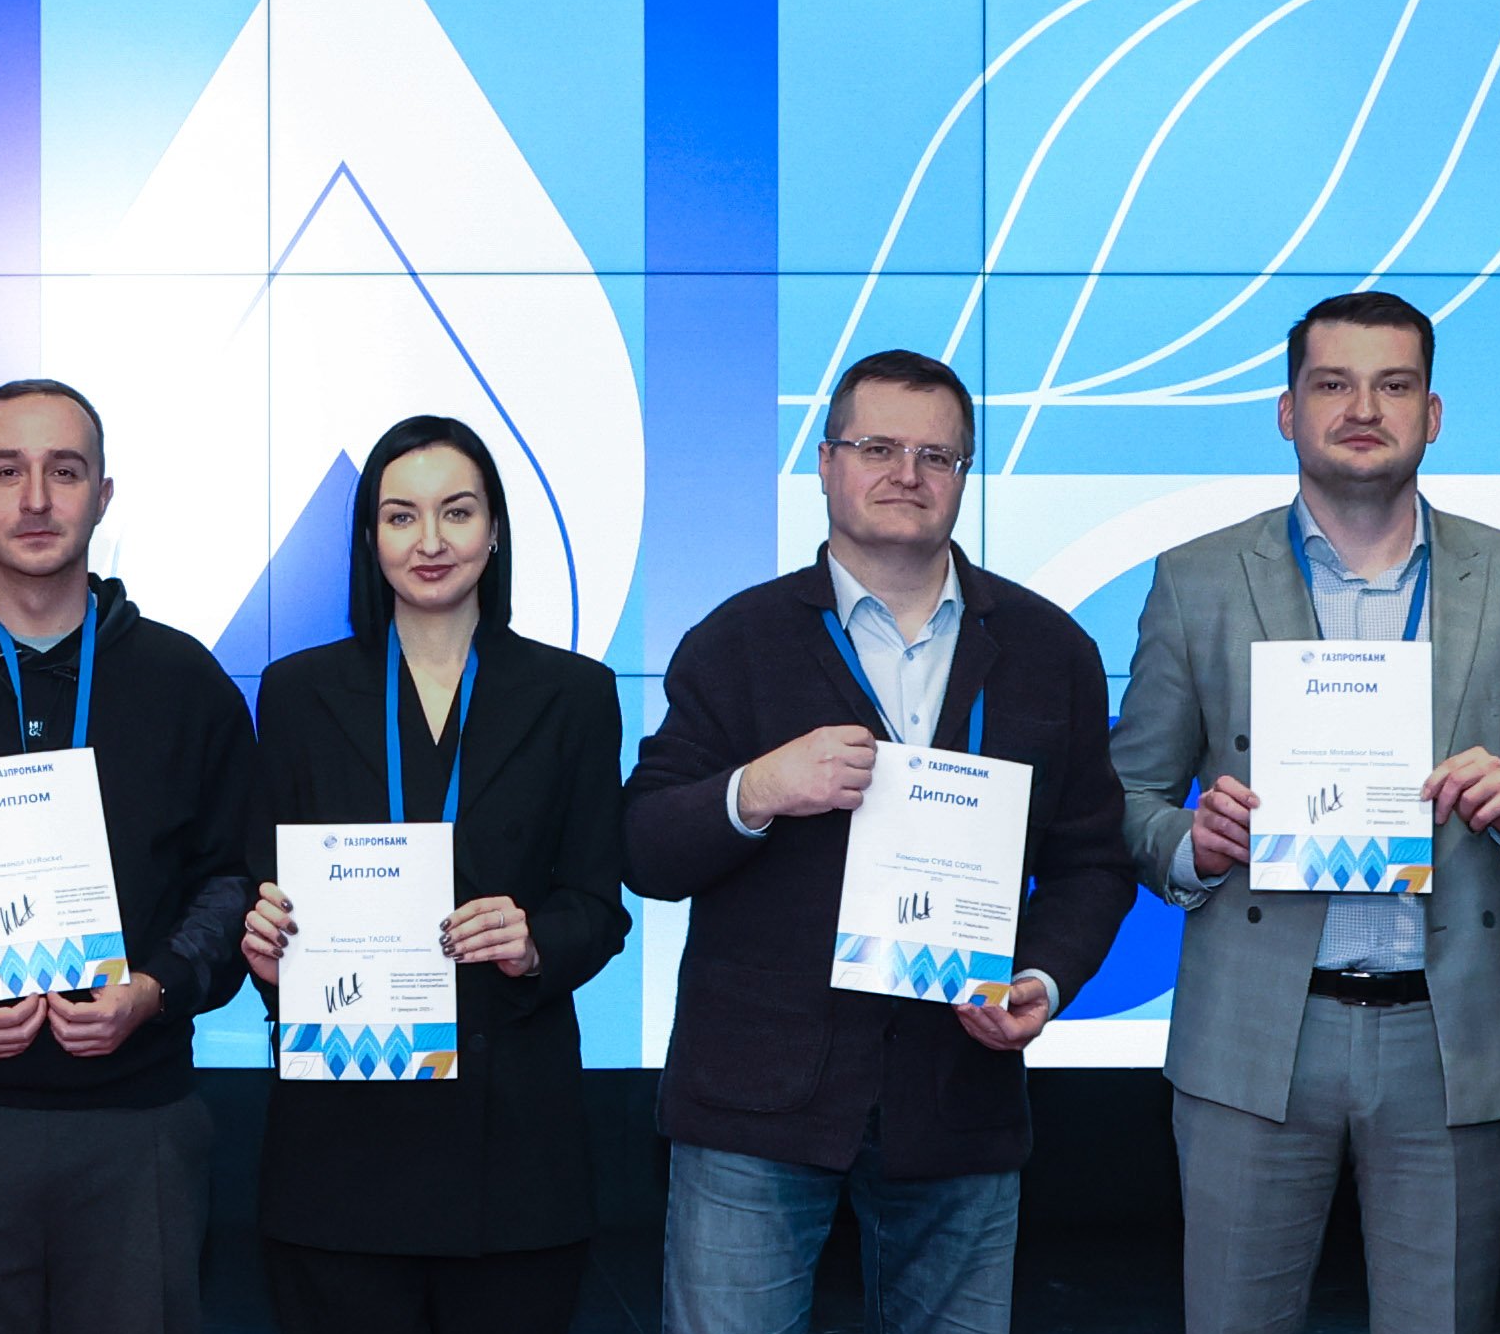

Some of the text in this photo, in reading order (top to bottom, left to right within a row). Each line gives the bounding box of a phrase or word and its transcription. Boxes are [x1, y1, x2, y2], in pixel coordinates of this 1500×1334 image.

[1322, 653, 1386, 662] ГАЗПРОМБАНК
[1306, 679, 1378, 695] Диплом
[928, 760, 991, 779] ГАЗПРОМБАНК
[908, 784, 979, 808] Диплом
[344, 836, 408, 847] ГАЗПРОМБАНК
[329, 864, 401, 881] Диплом
